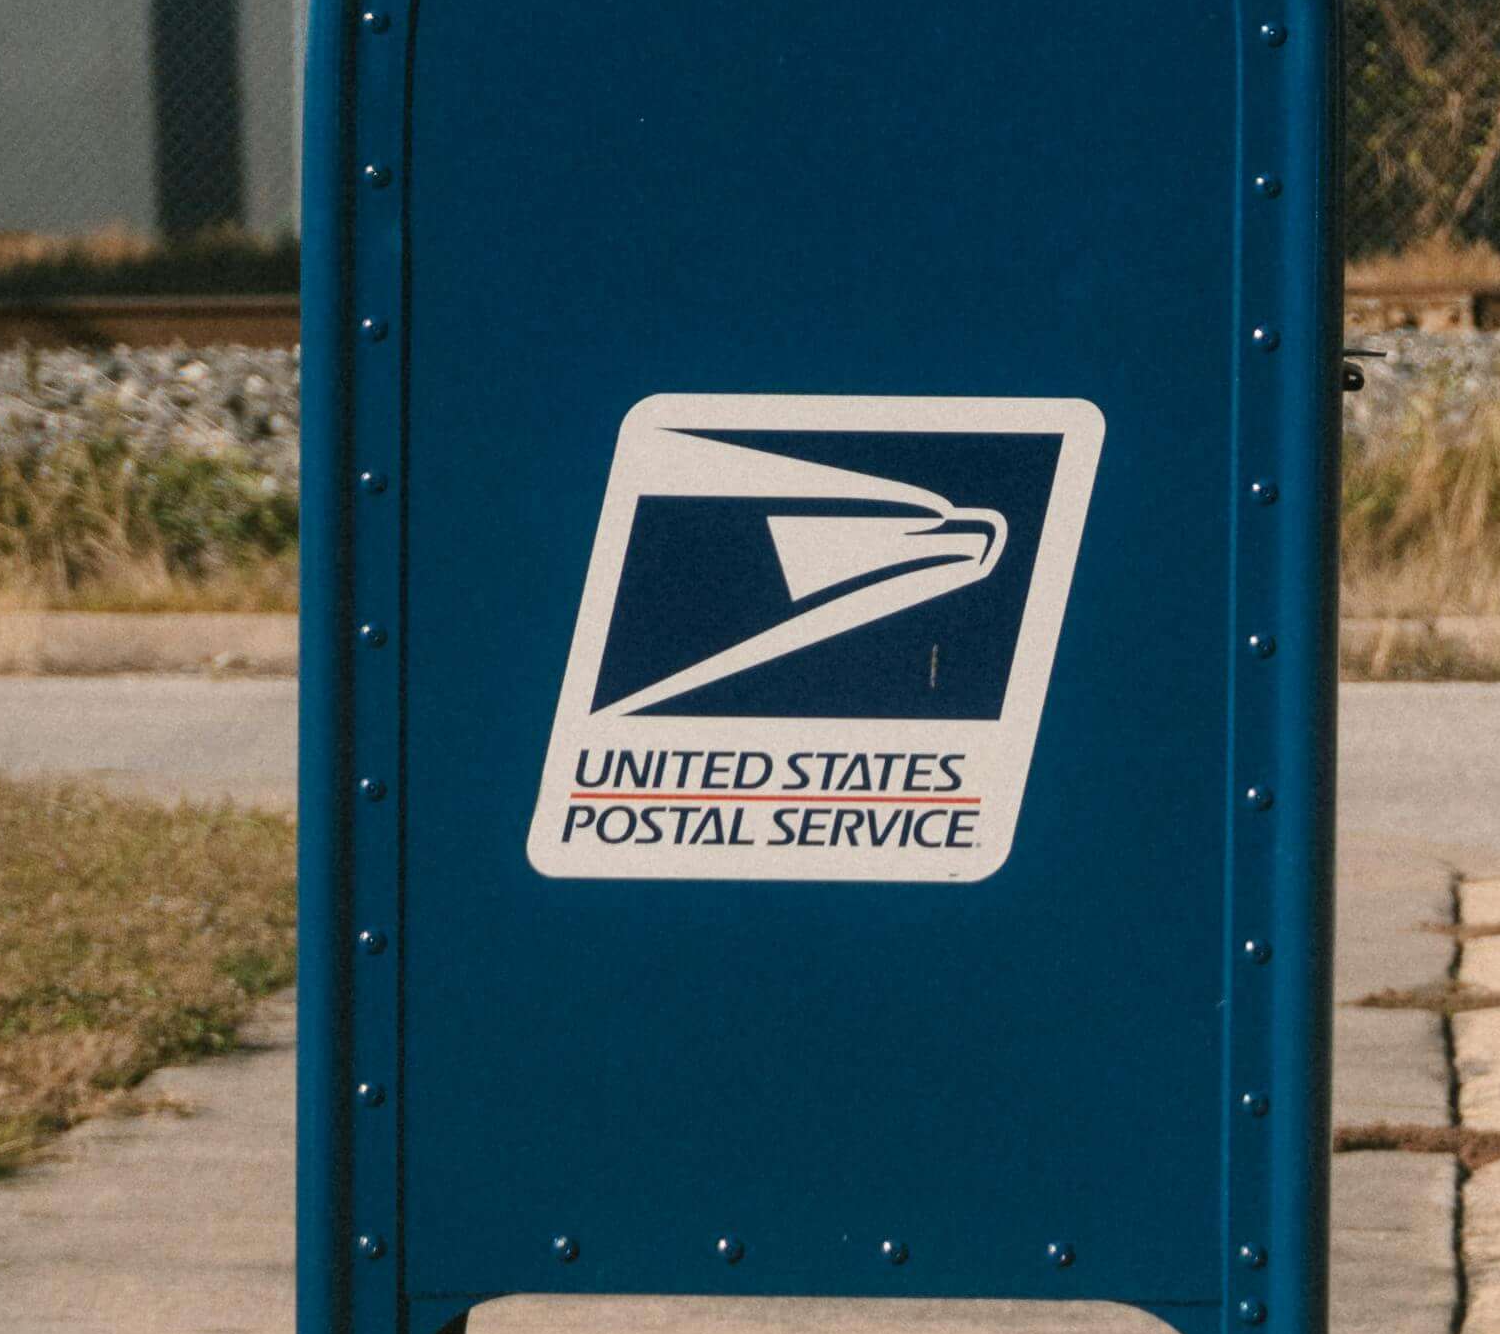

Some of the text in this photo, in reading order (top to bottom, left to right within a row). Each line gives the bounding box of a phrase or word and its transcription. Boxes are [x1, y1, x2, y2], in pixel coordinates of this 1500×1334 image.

[575, 749, 966, 792] UNITED STATES
[561, 805, 980, 849] POSTAL SERVICE
